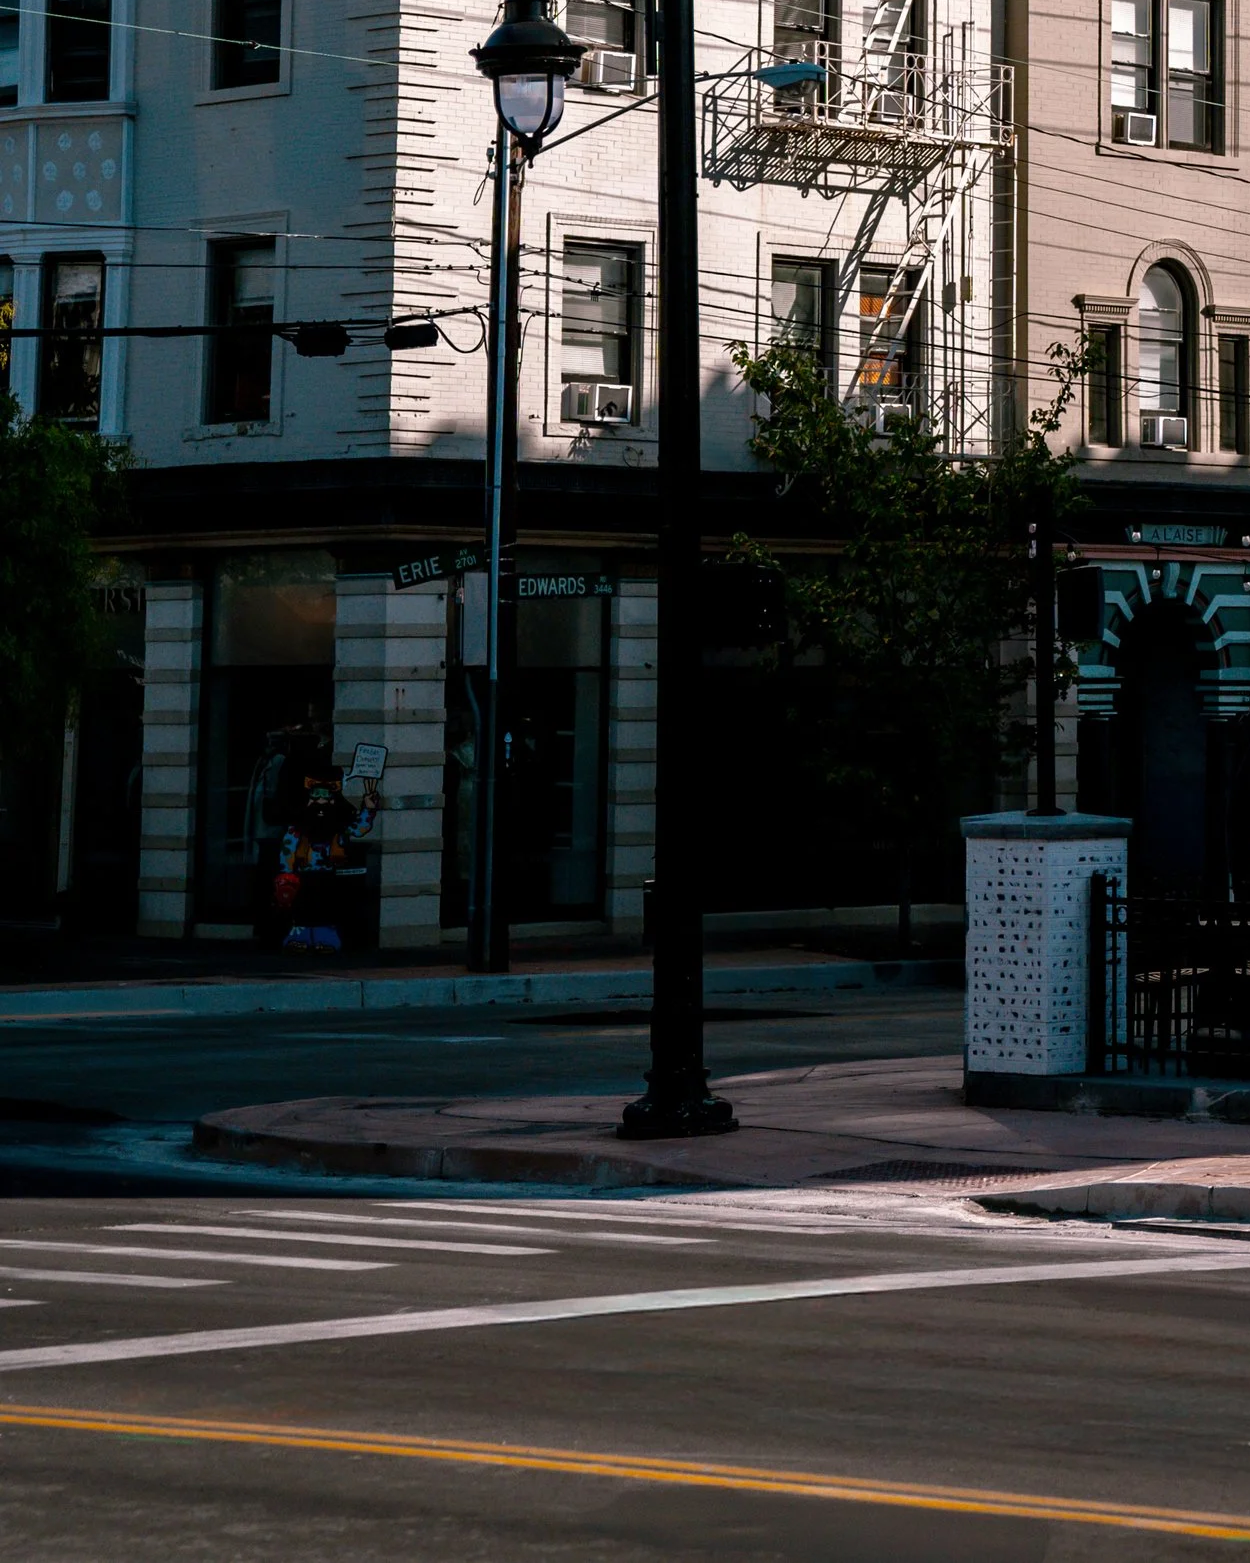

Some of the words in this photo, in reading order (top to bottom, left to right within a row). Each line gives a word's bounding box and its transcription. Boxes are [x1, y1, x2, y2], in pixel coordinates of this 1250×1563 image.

[1152, 527, 1160, 541] A
[398, 555, 443, 584] ERIE
[455, 555, 477, 570] 2701
[518, 576, 586, 596] EDWARDS
[593, 584, 613, 594] 3446
